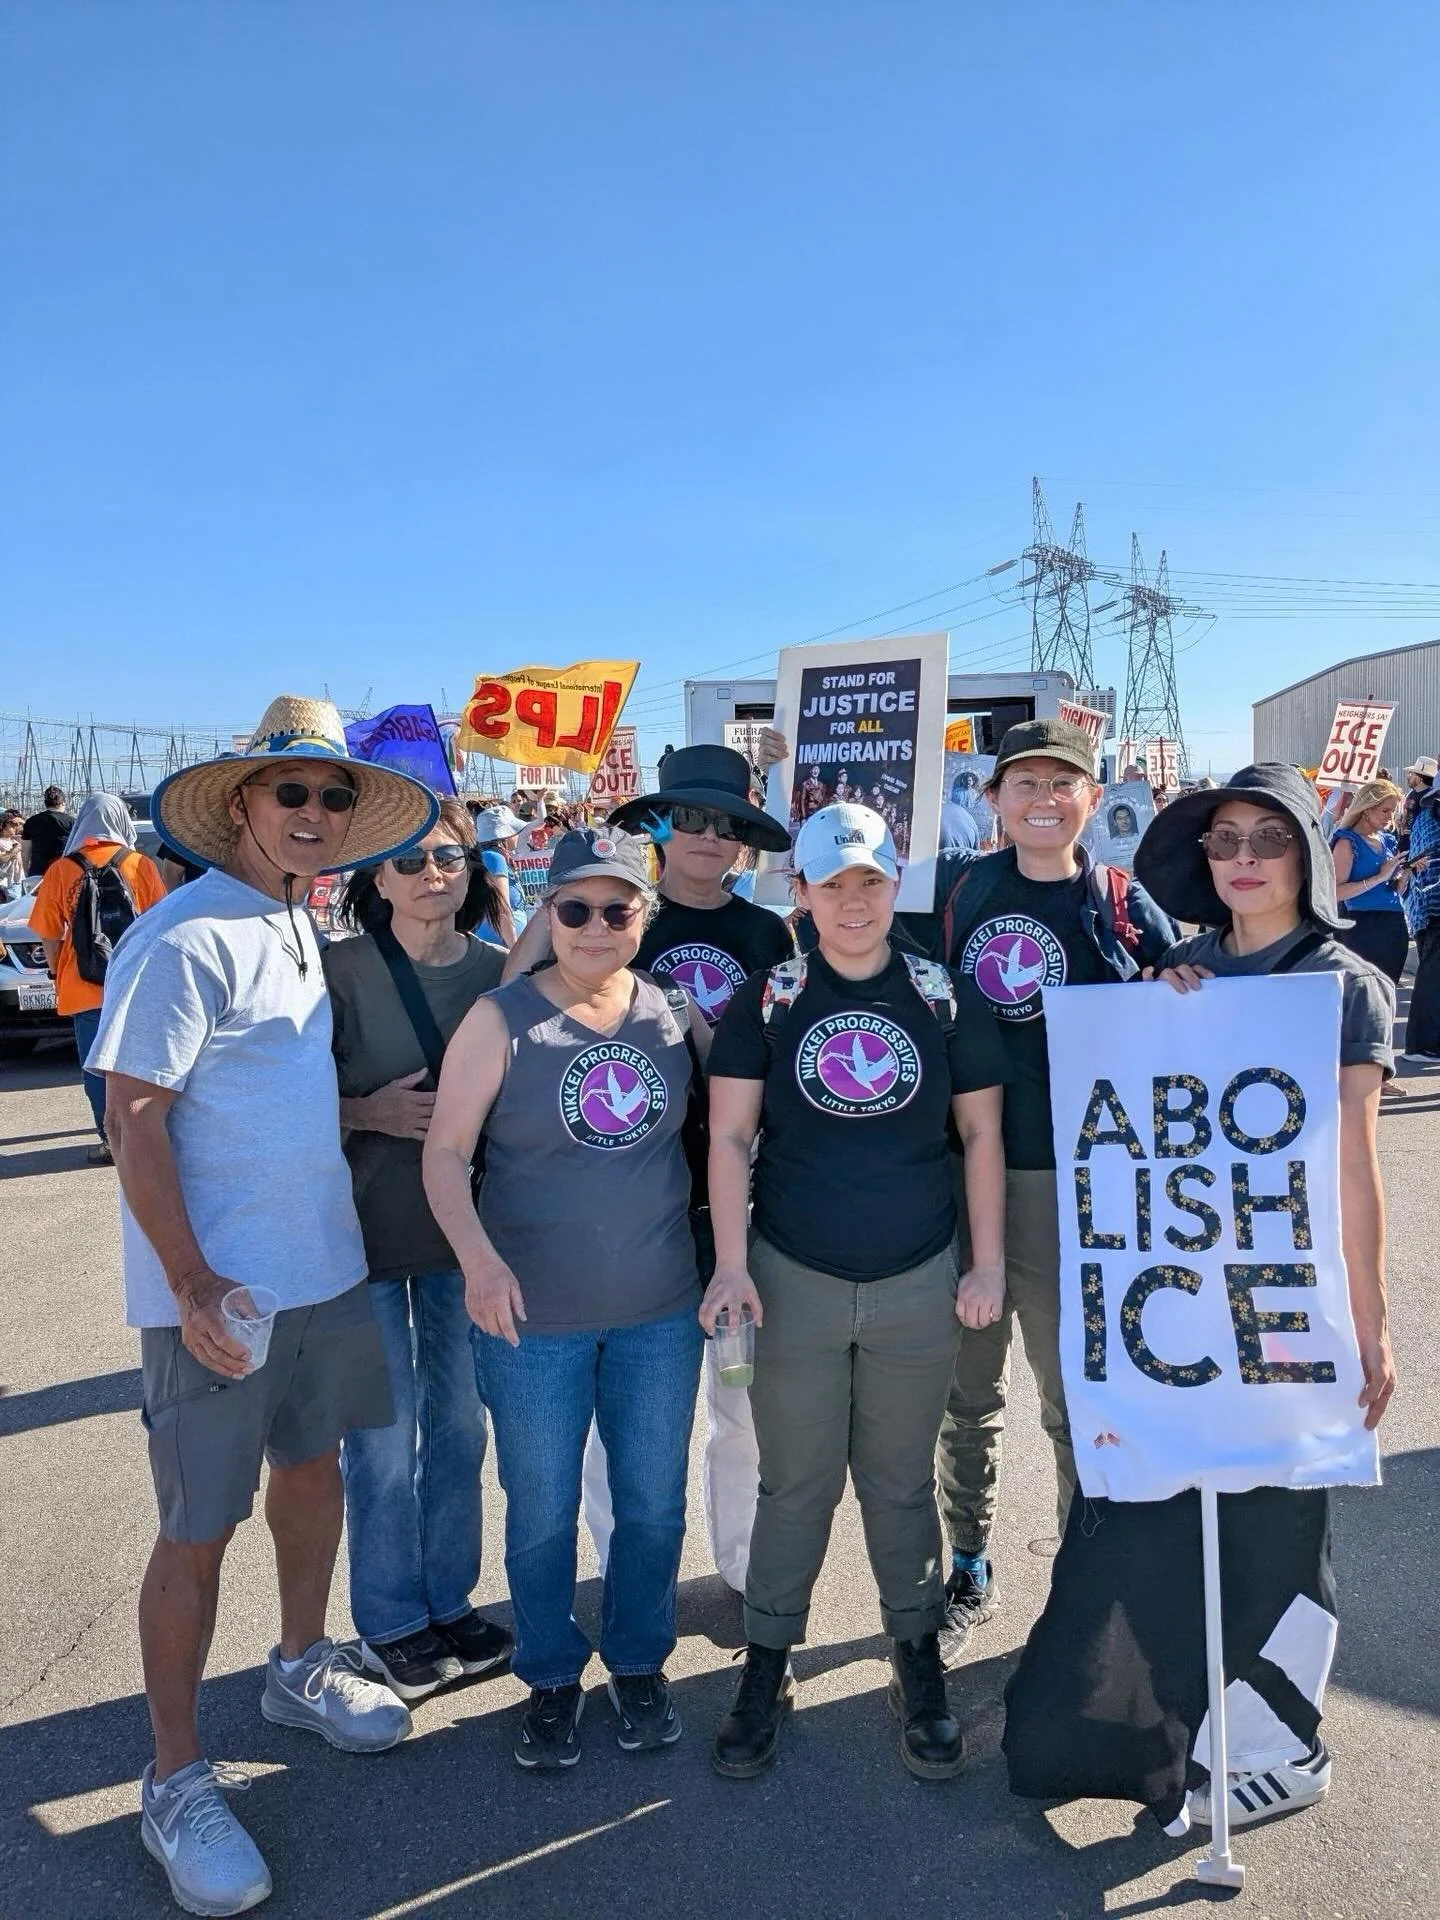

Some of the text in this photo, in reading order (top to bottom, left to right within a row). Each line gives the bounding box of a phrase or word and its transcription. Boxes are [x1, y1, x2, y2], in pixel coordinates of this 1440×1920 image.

[822, 672, 896, 689] STAND FOR
[803, 690, 916, 717] JUSTICE
[732, 736, 741, 744] LA
[830, 720, 884, 735] FOR ALL
[1330, 720, 1383, 750] ICE
[604, 748, 633, 770] CE
[798, 739, 913, 764] IMMIGRANTS
[1322, 749, 1378, 780] OUT!
[521, 767, 565, 785] FOR ALL
[592, 772, 638, 793] OUT!
[964, 927, 992, 974] NIKKEI
[671, 947, 744, 986] PROGRESSI
[1002, 1004, 1032, 1017] TOKYO
[801, 1016, 916, 1083] NIKKEI PROGRESSIVES
[565, 1046, 665, 1123] NIKKEI PROGRESSIVES
[821, 1094, 897, 1112] LITTLE TOKYO
[1073, 1067, 1307, 1161] ABO
[620, 1122, 650, 1143] TOKYO
[1074, 1160, 1313, 1252] LISH
[1080, 1263, 1337, 1388] ICE
